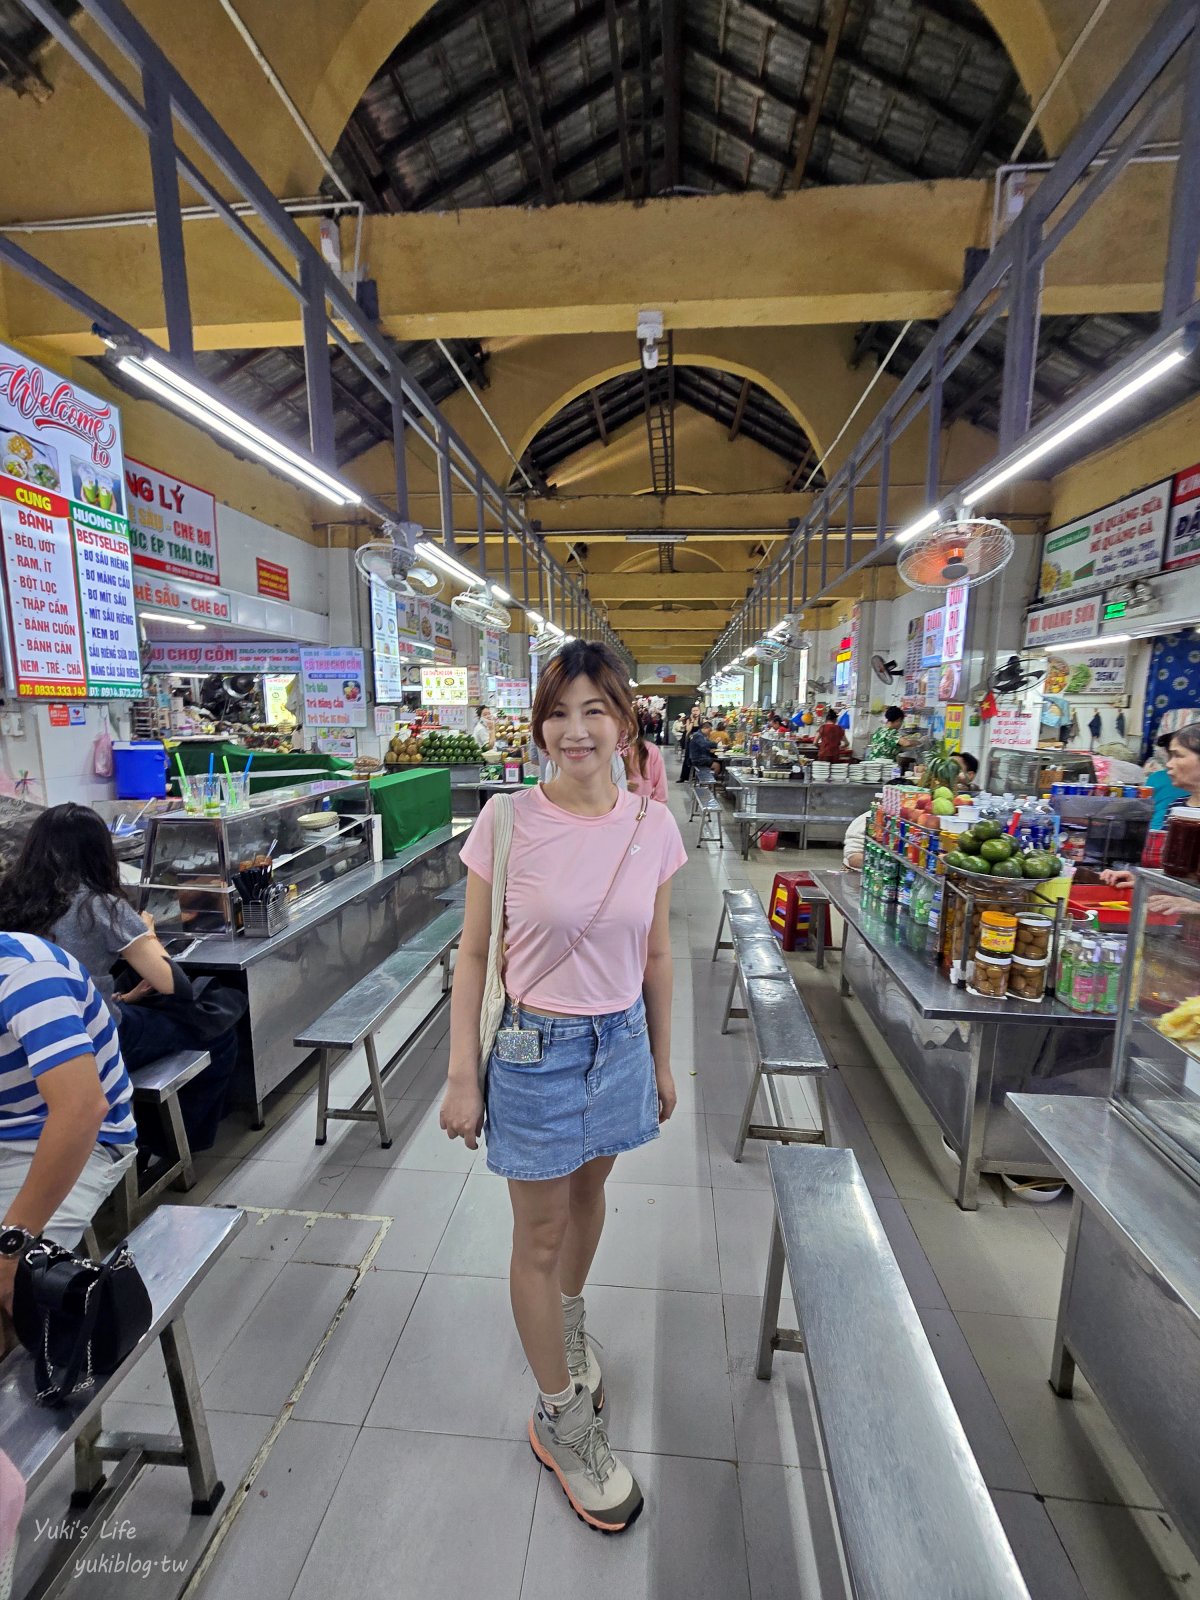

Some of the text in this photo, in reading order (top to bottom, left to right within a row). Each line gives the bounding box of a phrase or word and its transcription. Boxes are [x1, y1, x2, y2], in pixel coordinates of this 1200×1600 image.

[1, 363, 116, 448] Welcome
[91, 442, 110, 468] to
[15, 487, 52, 511] CUNG
[158, 484, 185, 514] LÝ
[18, 510, 54, 534] BÁNH
[76, 528, 129, 556] BESTSELLER
[151, 534, 164, 555] ÉP
[167, 540, 193, 563] TRÁI
[24, 616, 50, 632] BÁNH
[91, 627, 108, 640] KEM
[27, 637, 52, 653] BÁNH
[20, 660, 39, 673] NEM
